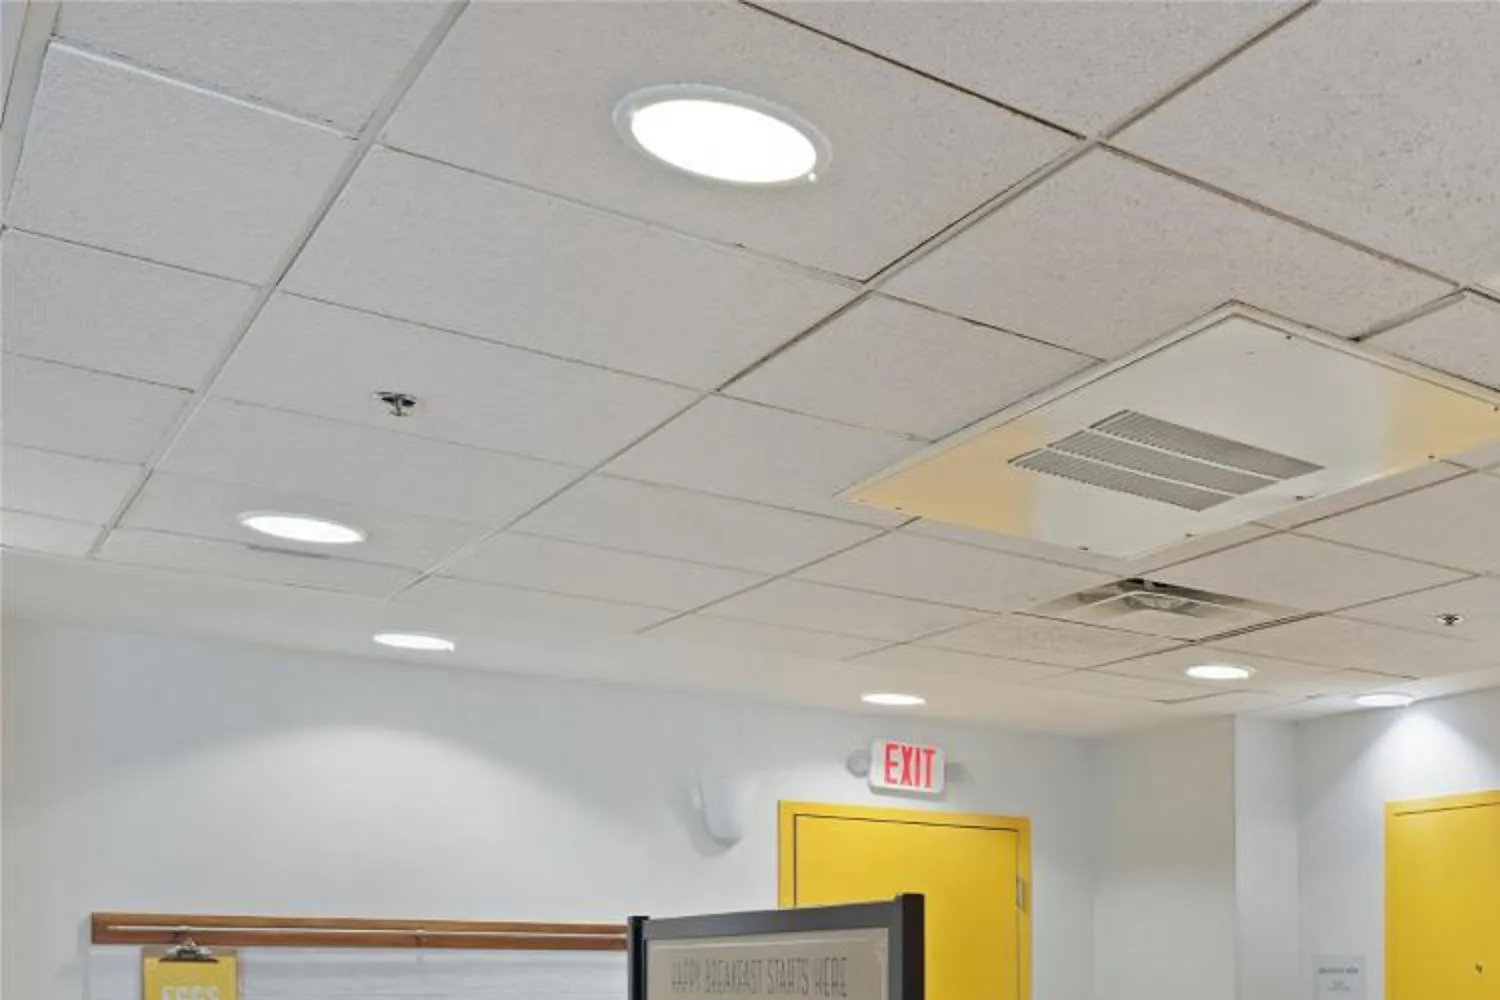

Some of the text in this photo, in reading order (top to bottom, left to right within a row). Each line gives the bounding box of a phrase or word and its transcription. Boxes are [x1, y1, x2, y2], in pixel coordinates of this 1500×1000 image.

[884, 742, 936, 788] EXIT
[705, 958, 763, 995] BREAKFAST
[767, 957, 809, 996] STARTS
[815, 956, 848, 998] HERE
